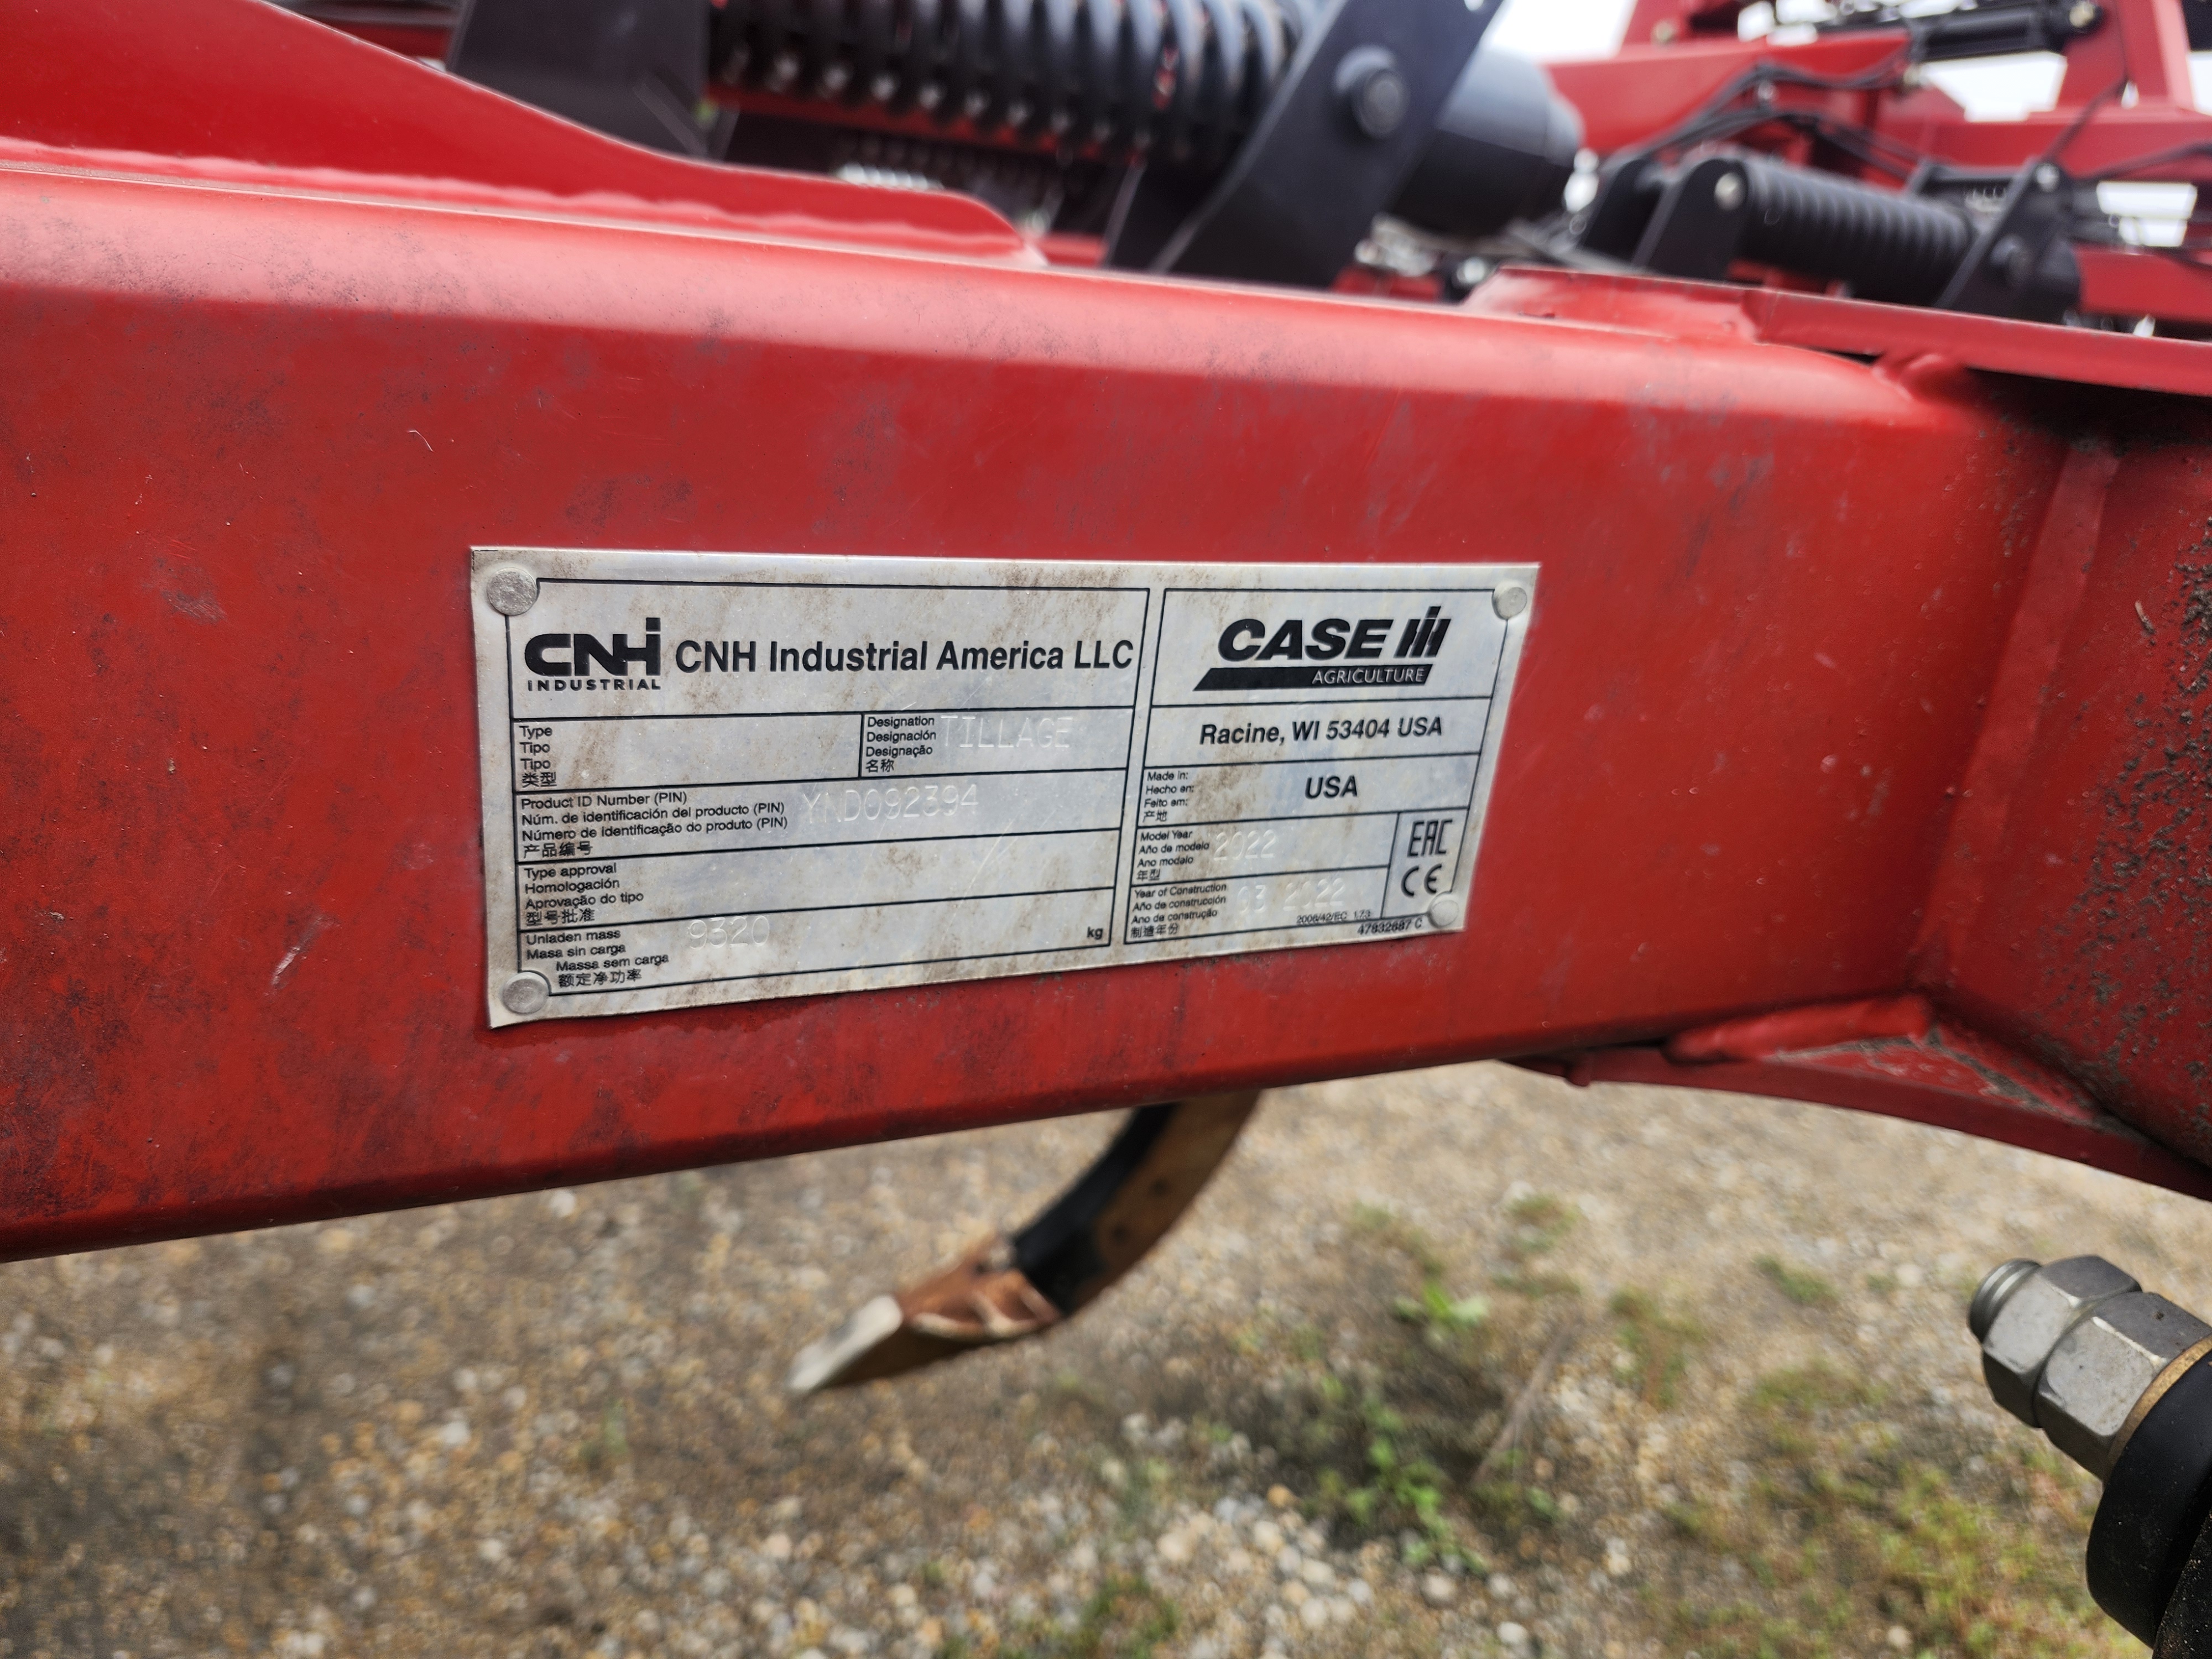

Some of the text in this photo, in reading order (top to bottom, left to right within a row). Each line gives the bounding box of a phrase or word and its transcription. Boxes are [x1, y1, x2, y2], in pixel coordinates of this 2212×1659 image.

[1218, 618, 1394, 661] CASE
[675, 640, 1134, 674] CNH Industrial America LLC
[1312, 666, 1425, 685] AGRICULTURE
[527, 679, 661, 692] INDUSTRIAL
[867, 716, 935, 729] Designation
[519, 726, 552, 739] Type
[866, 729, 936, 744] Designación
[940, 715, 1073, 748] TILLAGE
[1199, 716, 1443, 746] Racine, WI 53404 USA
[519, 742, 551, 756] Tipo
[865, 745, 933, 759] Designação
[520, 758, 551, 771] Tipo
[865, 759, 895, 773] 名称
[522, 771, 557, 788] 类型
[1147, 771, 1188, 781] Made in:
[1145, 784, 1177, 795] Hecho
[1304, 775, 1358, 800] USA
[521, 791, 687, 810] Product ID Number (PIN)
[1144, 797, 1188, 808] Feito em:
[522, 802, 785, 826] Núm. de identificación del producto (PIN)
[1142, 810, 1167, 823] 产地
[522, 816, 787, 842] Número de identificação do produto (PIN)
[1140, 830, 1192, 842] Model Year
[1214, 830, 1276, 860] 2022
[1407, 818, 1453, 857] EAC
[523, 841, 593, 858] 产品编号
[1138, 842, 1209, 855] Año de modelo
[1137, 856, 1193, 868] Ano modelo
[524, 863, 617, 881] Type approval
[1136, 868, 1161, 881] 年型
[525, 878, 620, 894] Homologación
[1400, 863, 1442, 898] CE
[1134, 883, 1227, 899] Year of Construction
[1282, 878, 1345, 911] 2022
[525, 891, 644, 910] Aprovação do tipo
[1132, 895, 1226, 912] Año de construcción
[1131, 909, 1218, 925] Ano de construção
[1415, 917, 1423, 930] C
[526, 930, 621, 945] Unladen mass
[688, 915, 770, 950] 9320
[1087, 926, 1104, 940] kg
[526, 943, 626, 960] Masa sin carga
[556, 953, 670, 972] Massa sem carga
